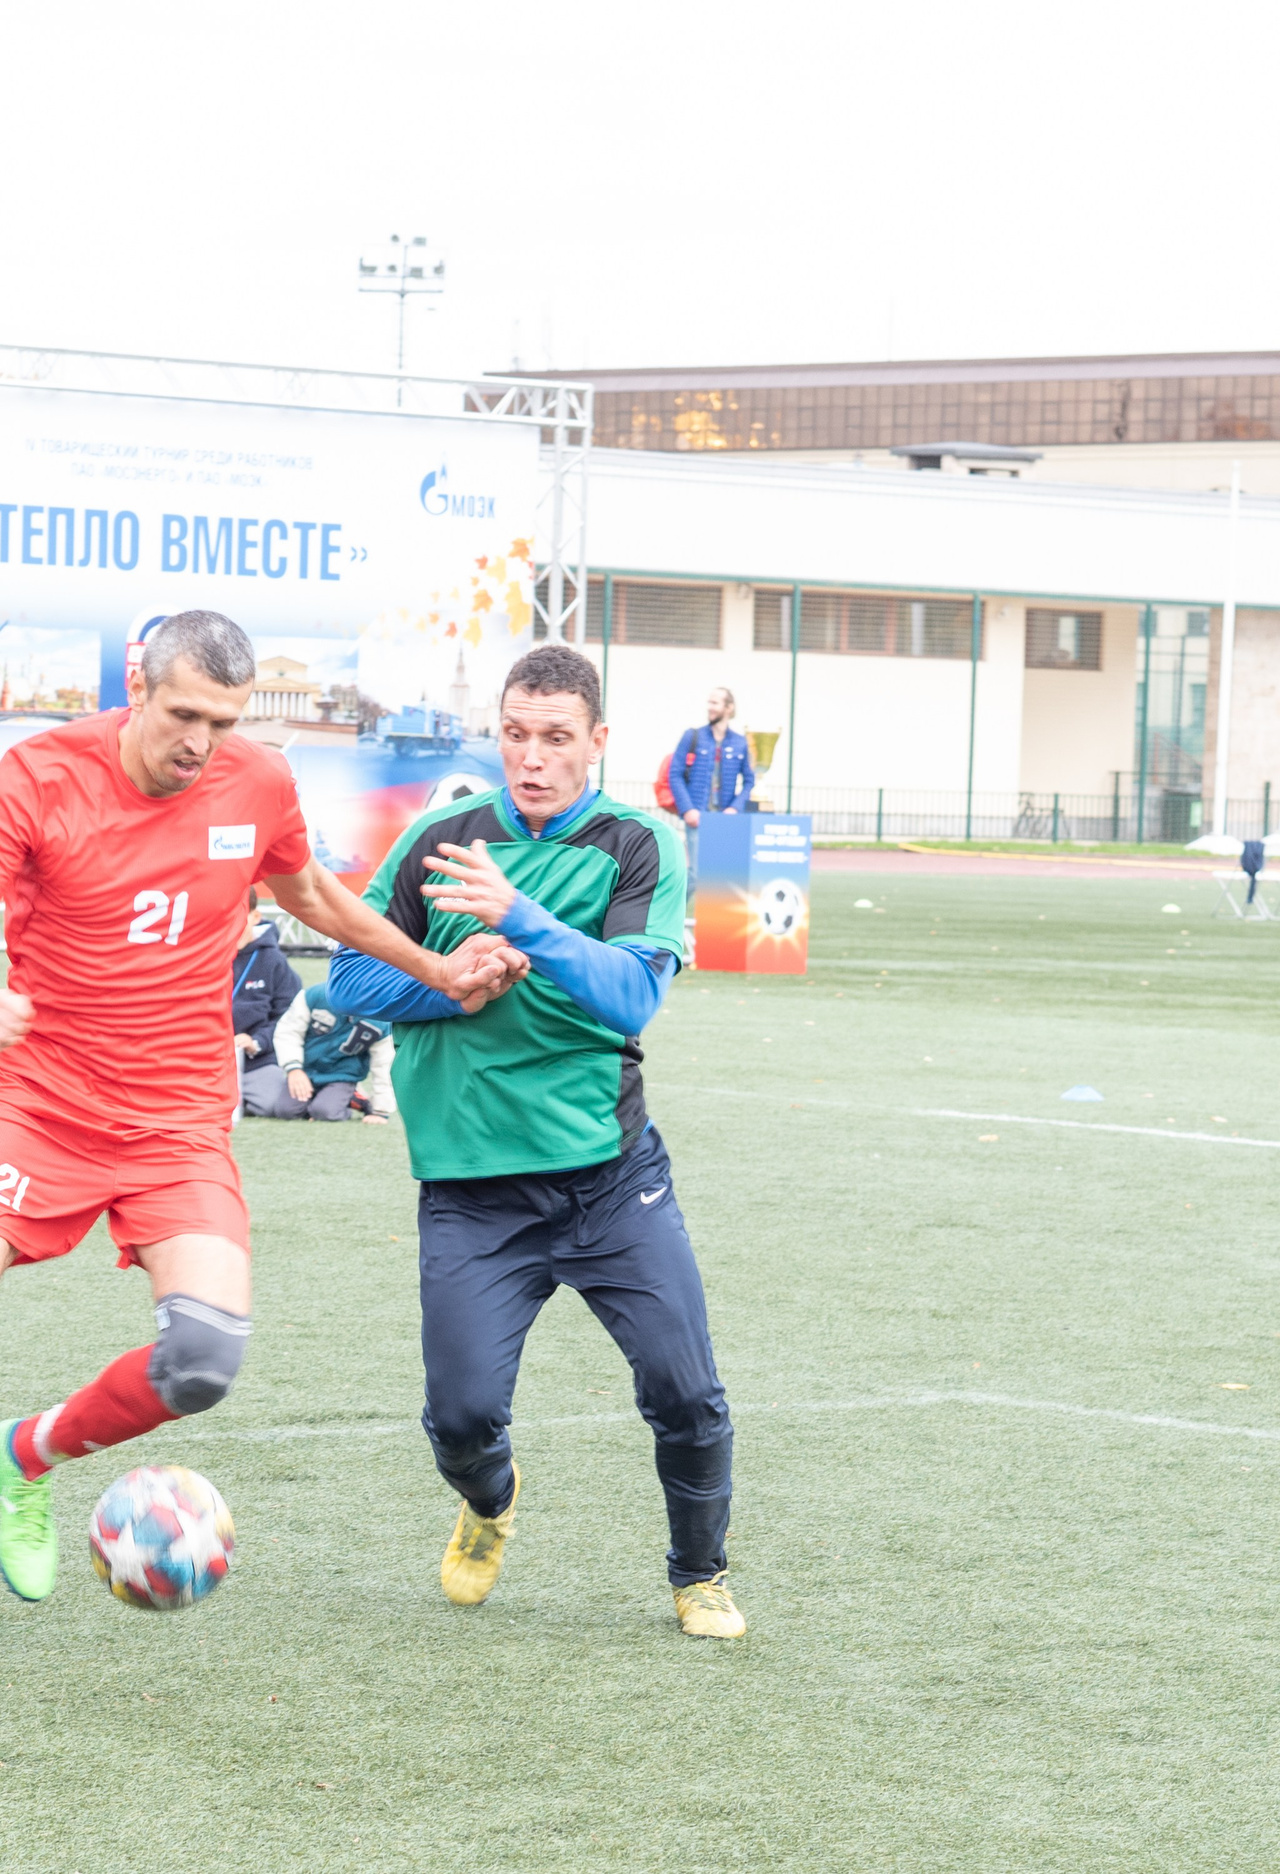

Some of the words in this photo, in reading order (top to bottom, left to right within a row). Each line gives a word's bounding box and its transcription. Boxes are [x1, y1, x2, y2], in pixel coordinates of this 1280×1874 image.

[41, 438, 139, 458] ТОВАРИЩЕСКИЙ
[144, 445, 189, 462] ТУРНИР
[194, 449, 233, 466] СРЕДИ
[237, 451, 314, 470] РАБОТНИКОВ
[71, 462, 95, 478] ПАО
[197, 470, 221, 486] ПАО
[451, 494, 496, 519] МОЭК
[160, 513, 369, 582] ВМЕСТЕ»
[127, 890, 189, 946] 21
